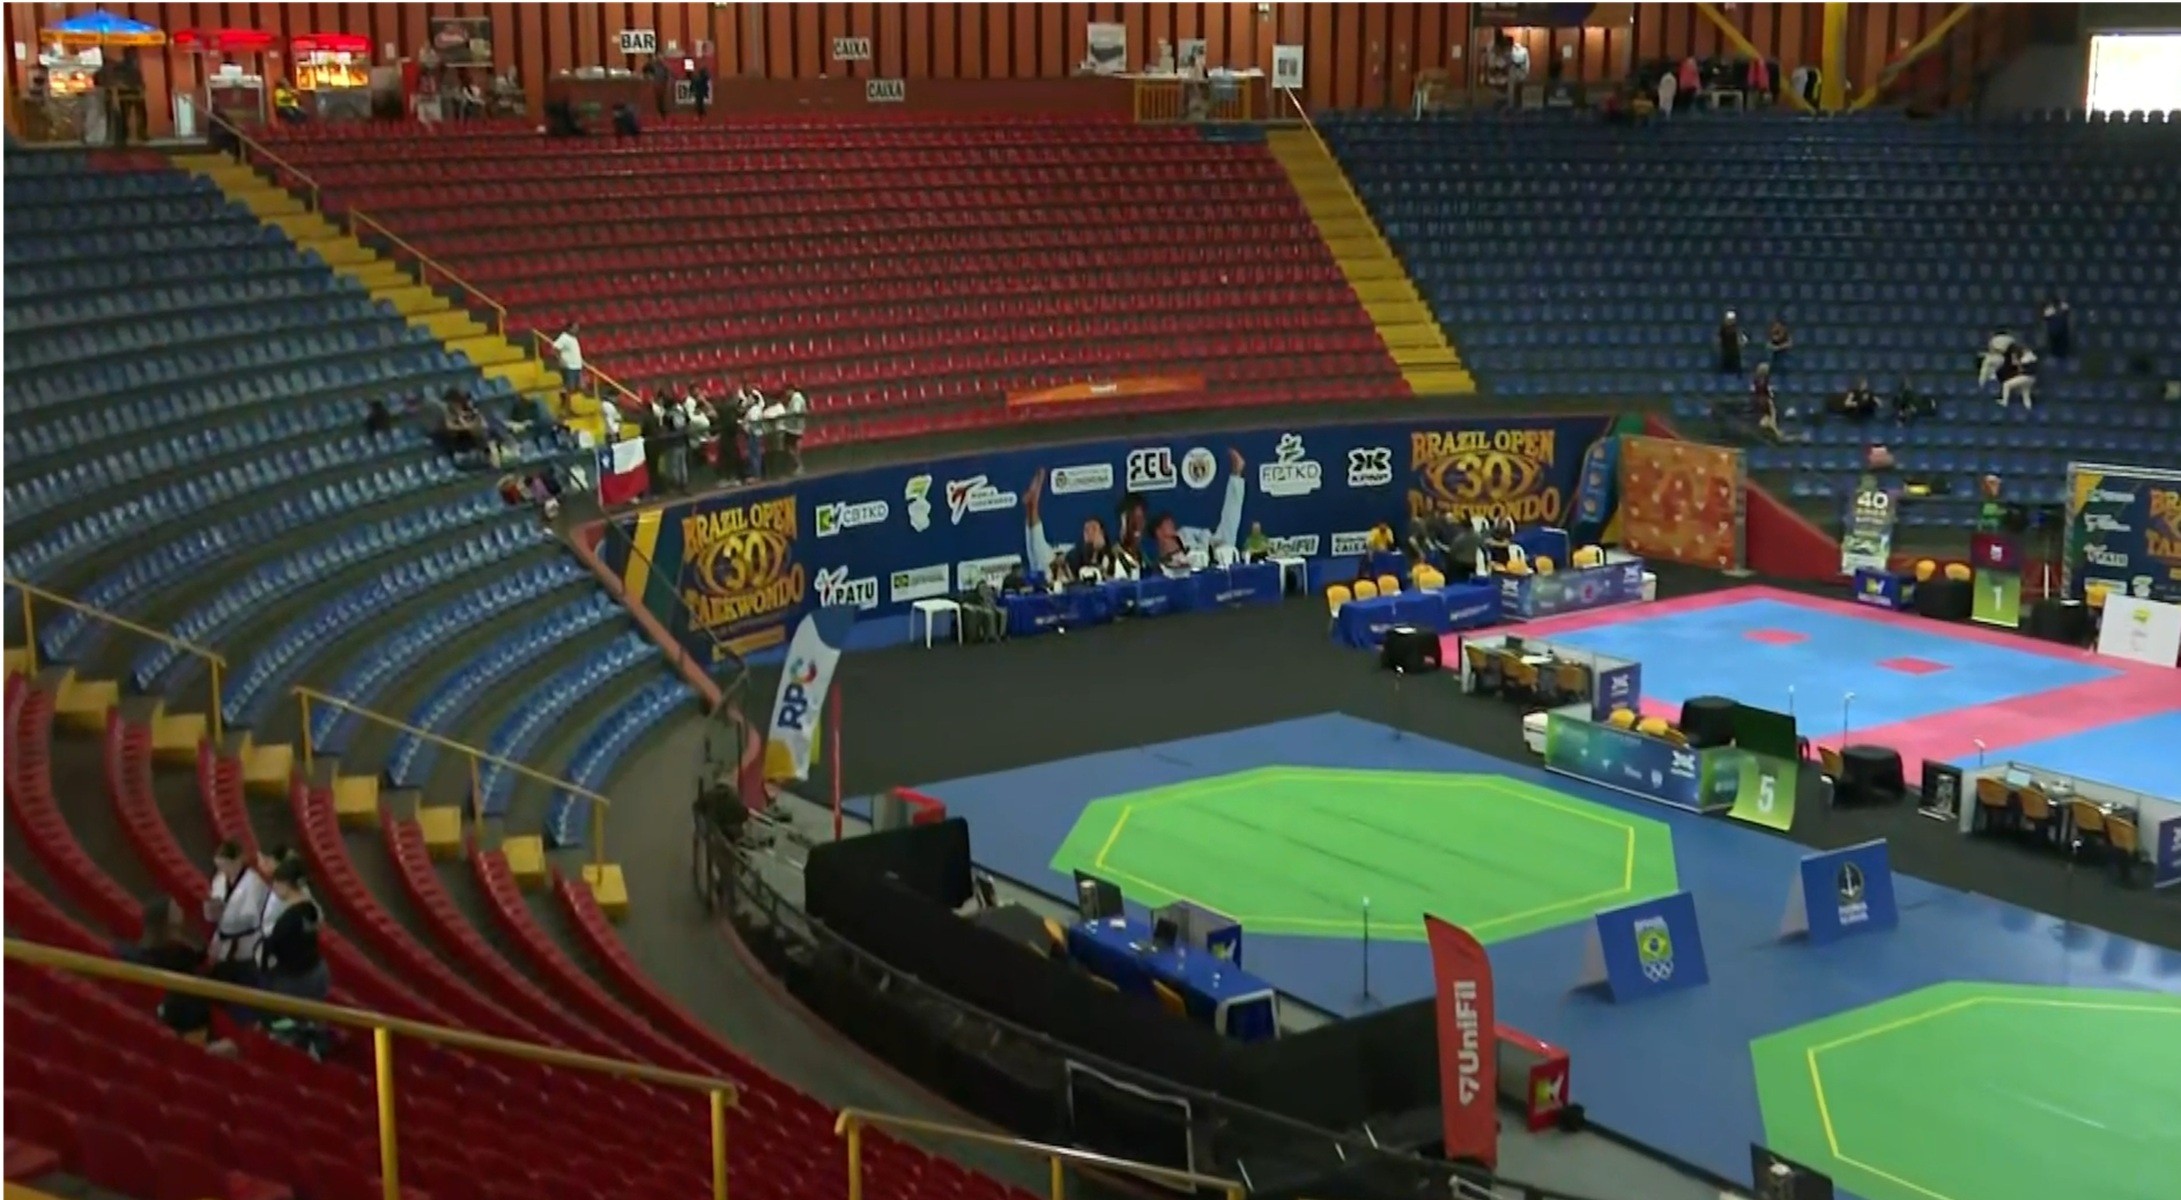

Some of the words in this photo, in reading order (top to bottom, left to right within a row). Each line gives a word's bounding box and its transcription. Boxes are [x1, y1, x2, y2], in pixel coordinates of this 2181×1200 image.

[621, 33, 655, 49] BAR
[834, 41, 868, 56] CAIXA
[868, 81, 903, 97] CAIXA
[1411, 430, 1491, 471] BRAZIL
[1494, 429, 1555, 467] OPEN
[1456, 452, 1512, 500] 30
[1856, 490, 1889, 509] 40
[682, 507, 748, 563] BRAZIL
[749, 495, 798, 541] OPEN
[723, 530, 768, 591] 30
[685, 562, 806, 632] TAEKWONDO
[835, 580, 876, 603] PATU
[1758, 773, 1776, 814] 5
[1453, 980, 1480, 1077] UniFil
